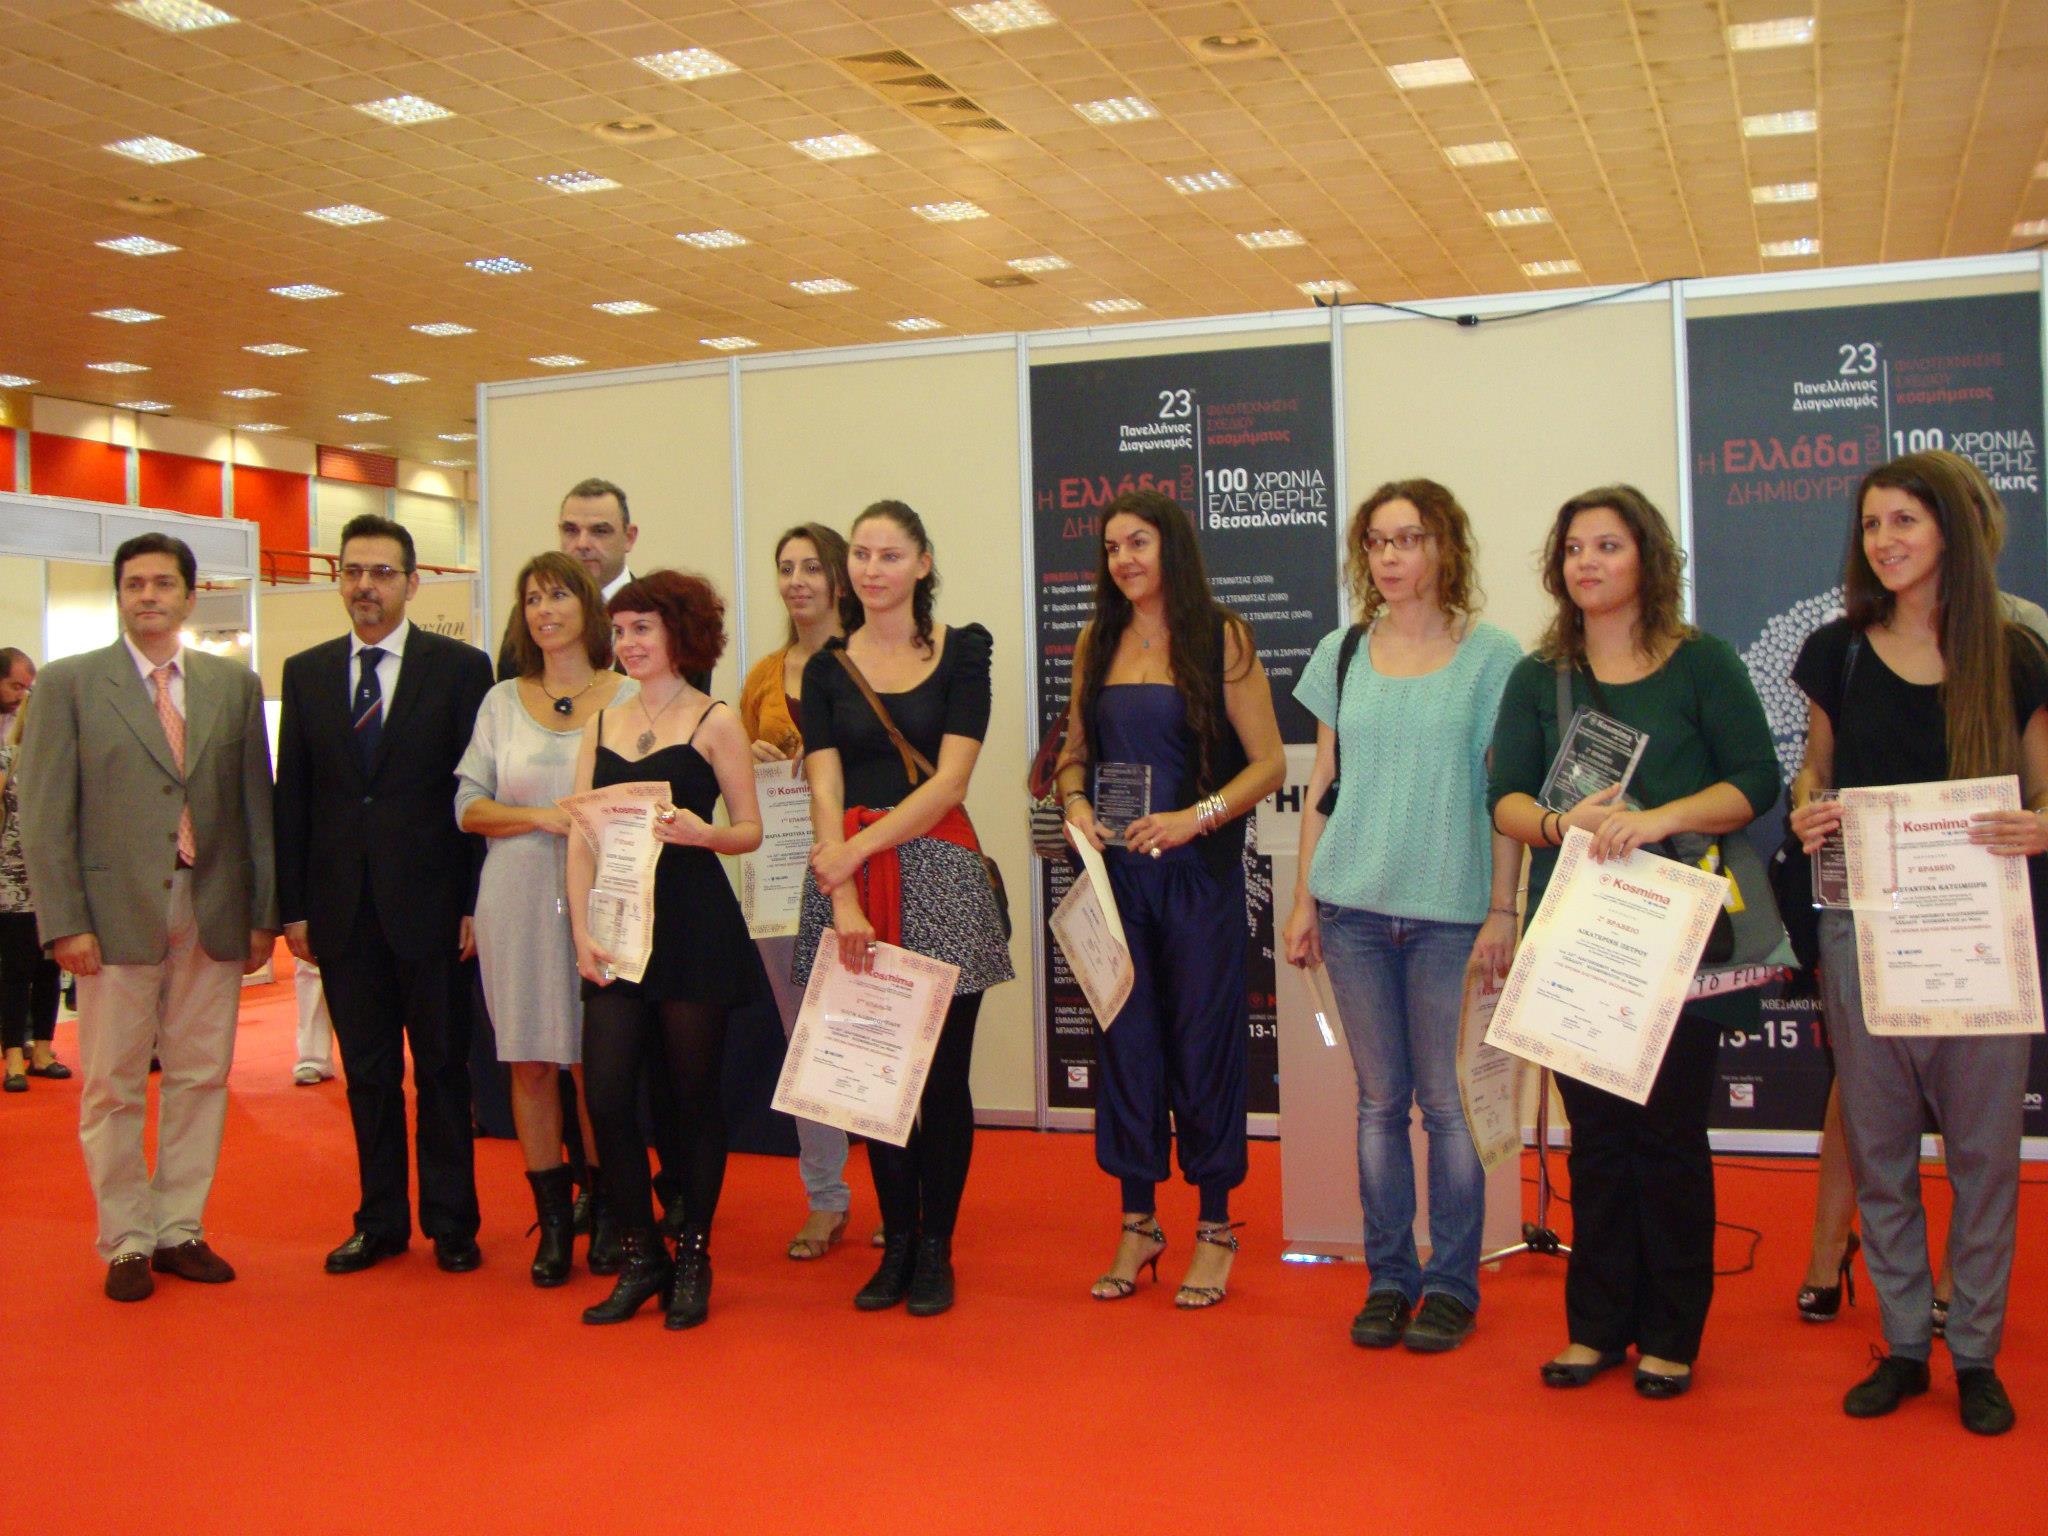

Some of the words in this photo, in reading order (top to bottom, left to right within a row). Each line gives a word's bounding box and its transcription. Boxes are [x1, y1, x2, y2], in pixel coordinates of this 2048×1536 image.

[1794, 378, 1878, 395] Πανελλήνιος
[1792, 394, 1878, 412] Διαγωνισμός
[1120, 422, 1192, 437] Πανελλήνιος
[1119, 436, 1192, 452] Διαγωνισμός
[1723, 433, 1860, 474] Ελλάδα
[1893, 428, 1944, 457] 100
[1951, 429, 2035, 452] ΧΡΟΝΙΑ
[1205, 467, 1248, 493] 100
[1254, 469, 1326, 491] ΧΡΟΝΙΑ
[1209, 487, 1328, 514] ΕΛΕΥΘΕΡΗΣ
[1903, 818, 1969, 834] Kosmima
[1612, 877, 1671, 906] Kosmima
